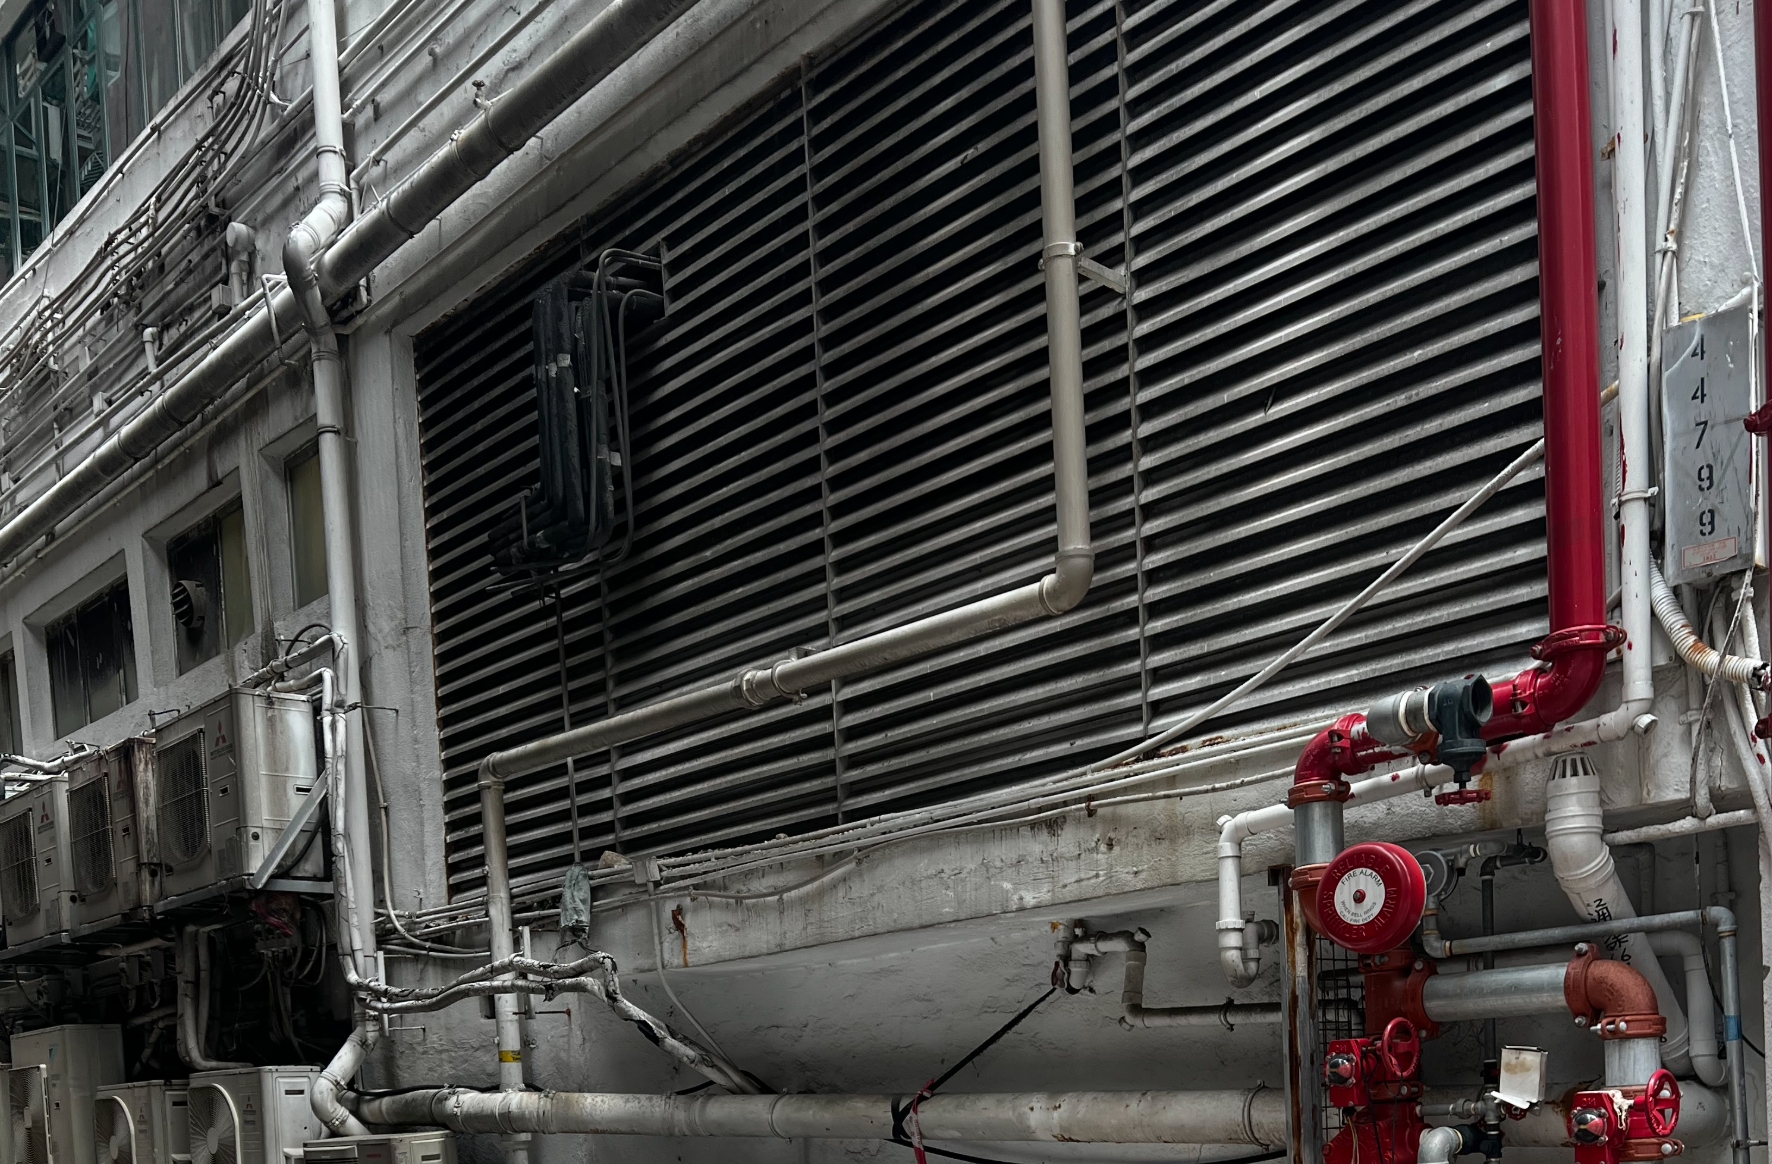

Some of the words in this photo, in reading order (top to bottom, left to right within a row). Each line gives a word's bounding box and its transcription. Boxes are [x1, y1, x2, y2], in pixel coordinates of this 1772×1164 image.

[1331, 853, 1390, 880] RELIABLE
[1341, 869, 1358, 886] FIRE
[1359, 869, 1382, 887] ALARM
[1339, 910, 1349, 921] CALL
[1341, 900, 1351, 915] WHEN
[1374, 887, 1397, 930] ALARM
